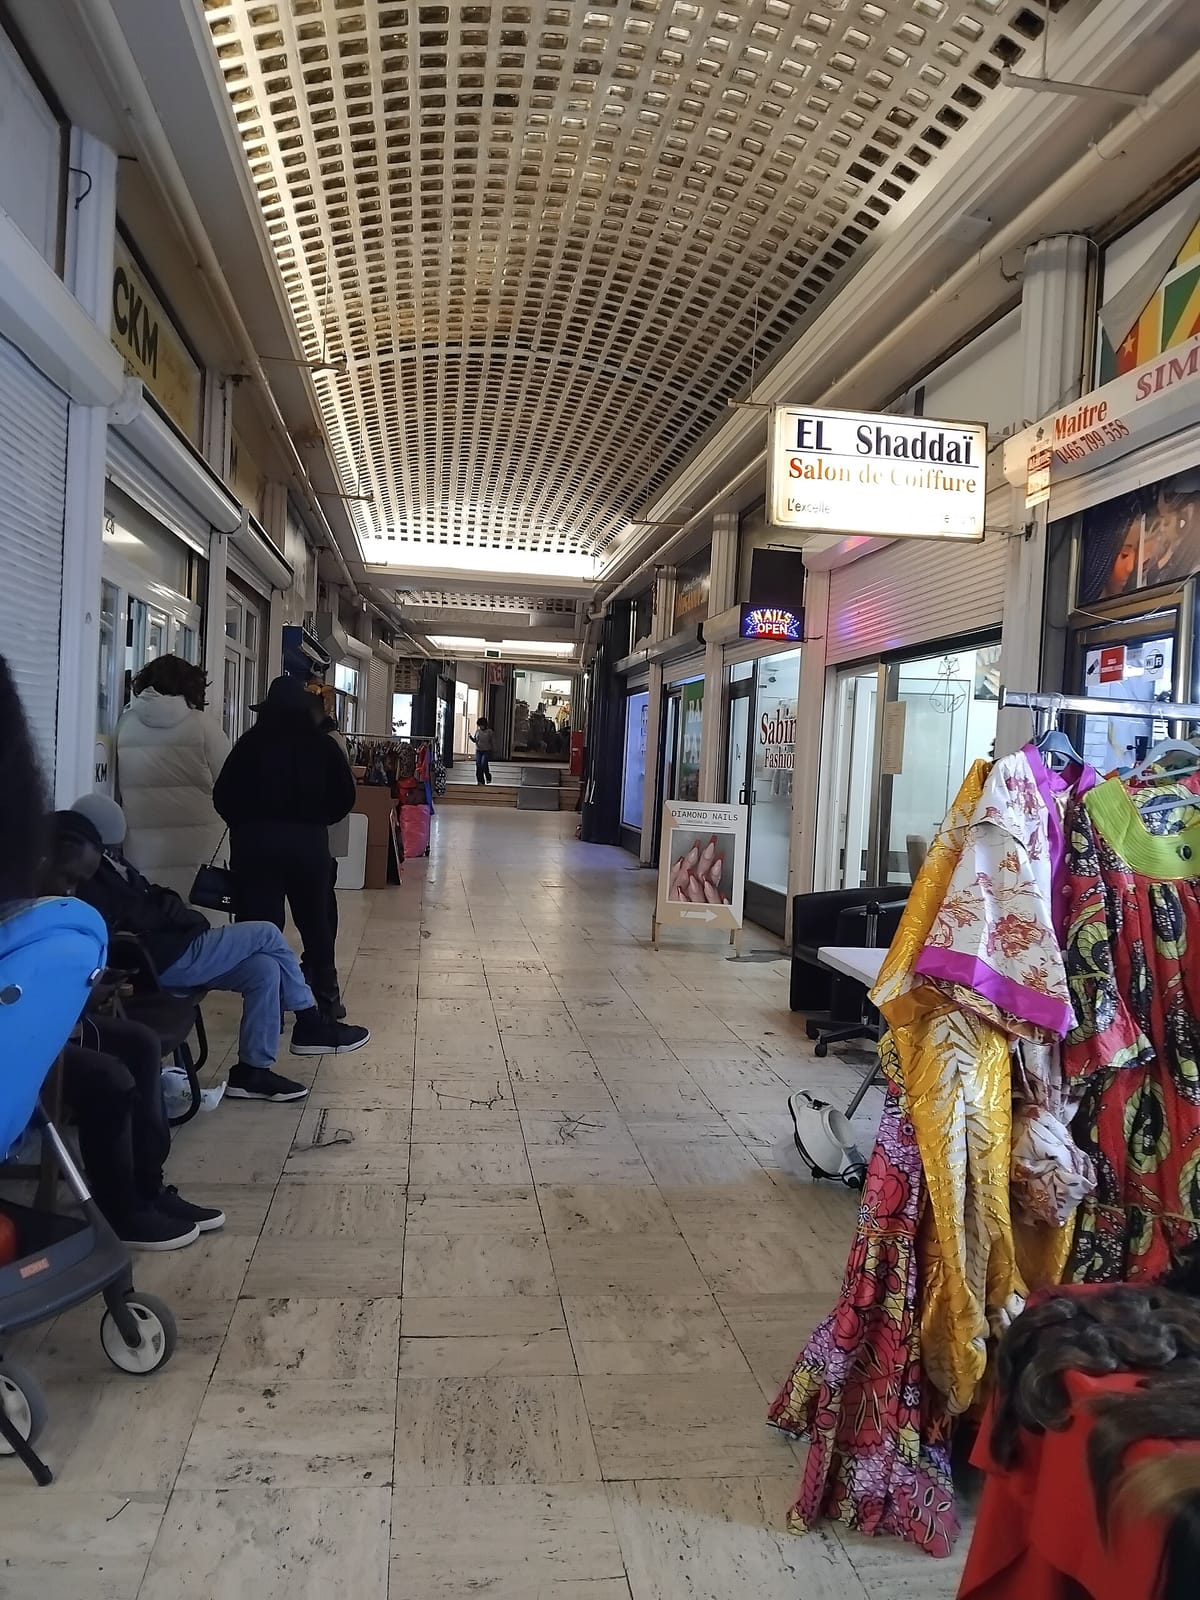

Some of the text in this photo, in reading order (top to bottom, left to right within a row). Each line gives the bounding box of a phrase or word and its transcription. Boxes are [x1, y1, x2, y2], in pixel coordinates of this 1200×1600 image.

[112, 266, 159, 380] CKM
[1054, 401, 1108, 441] Maitre
[796, 418, 974, 465] EL Shaddaï
[1055, 438, 1086, 465] 0465
[1080, 430, 1106, 452] 799
[1102, 418, 1130, 442] 558
[789, 457, 977, 493] Salon de Coiffure
[753, 609, 792, 624] NAILS
[757, 622, 788, 635] OPEN
[671, 810, 738, 821] DIAMOND NAILS
